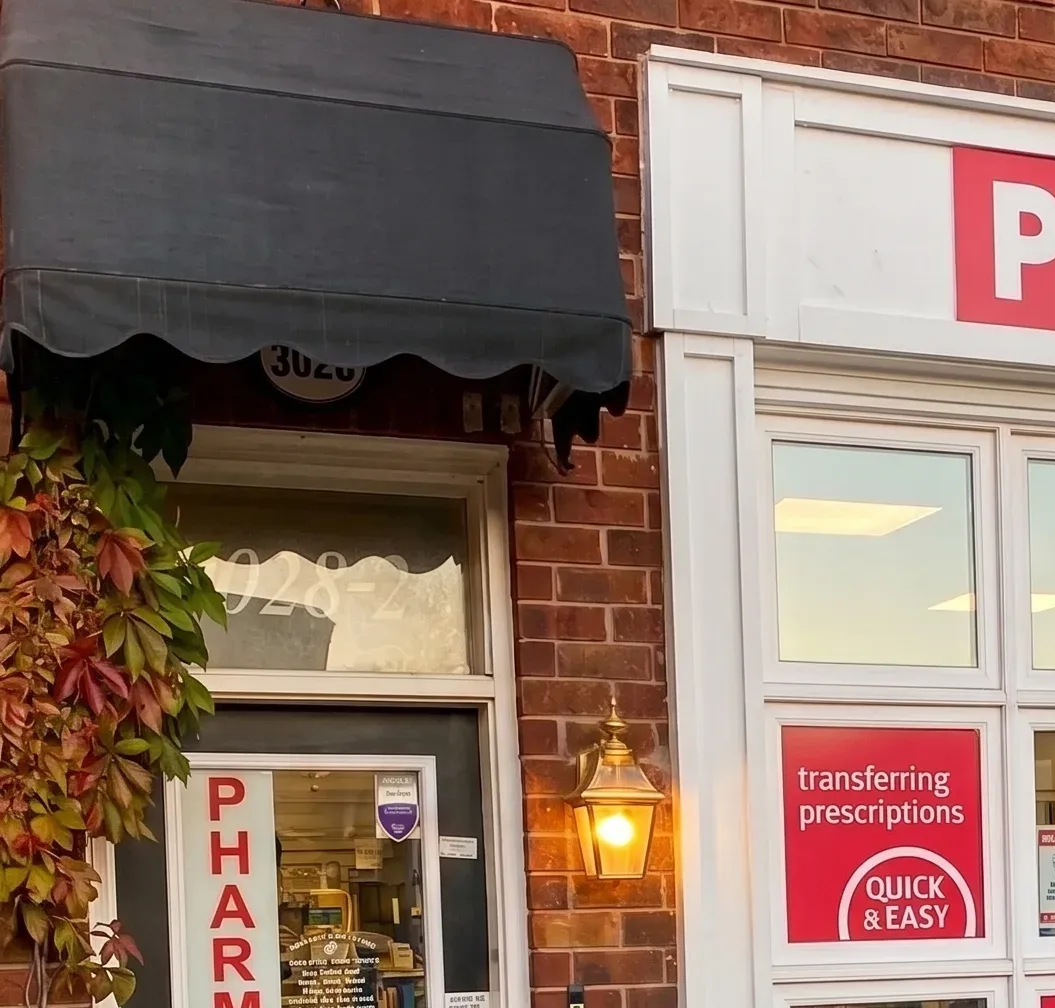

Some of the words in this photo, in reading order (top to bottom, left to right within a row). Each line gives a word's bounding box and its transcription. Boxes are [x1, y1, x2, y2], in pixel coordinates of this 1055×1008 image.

[798, 765, 951, 798] transferring
[799, 798, 965, 831] prescriptions
[865, 875, 946, 903] QUICK
[863, 909, 883, 931] &
[885, 904, 950, 930] EASY
